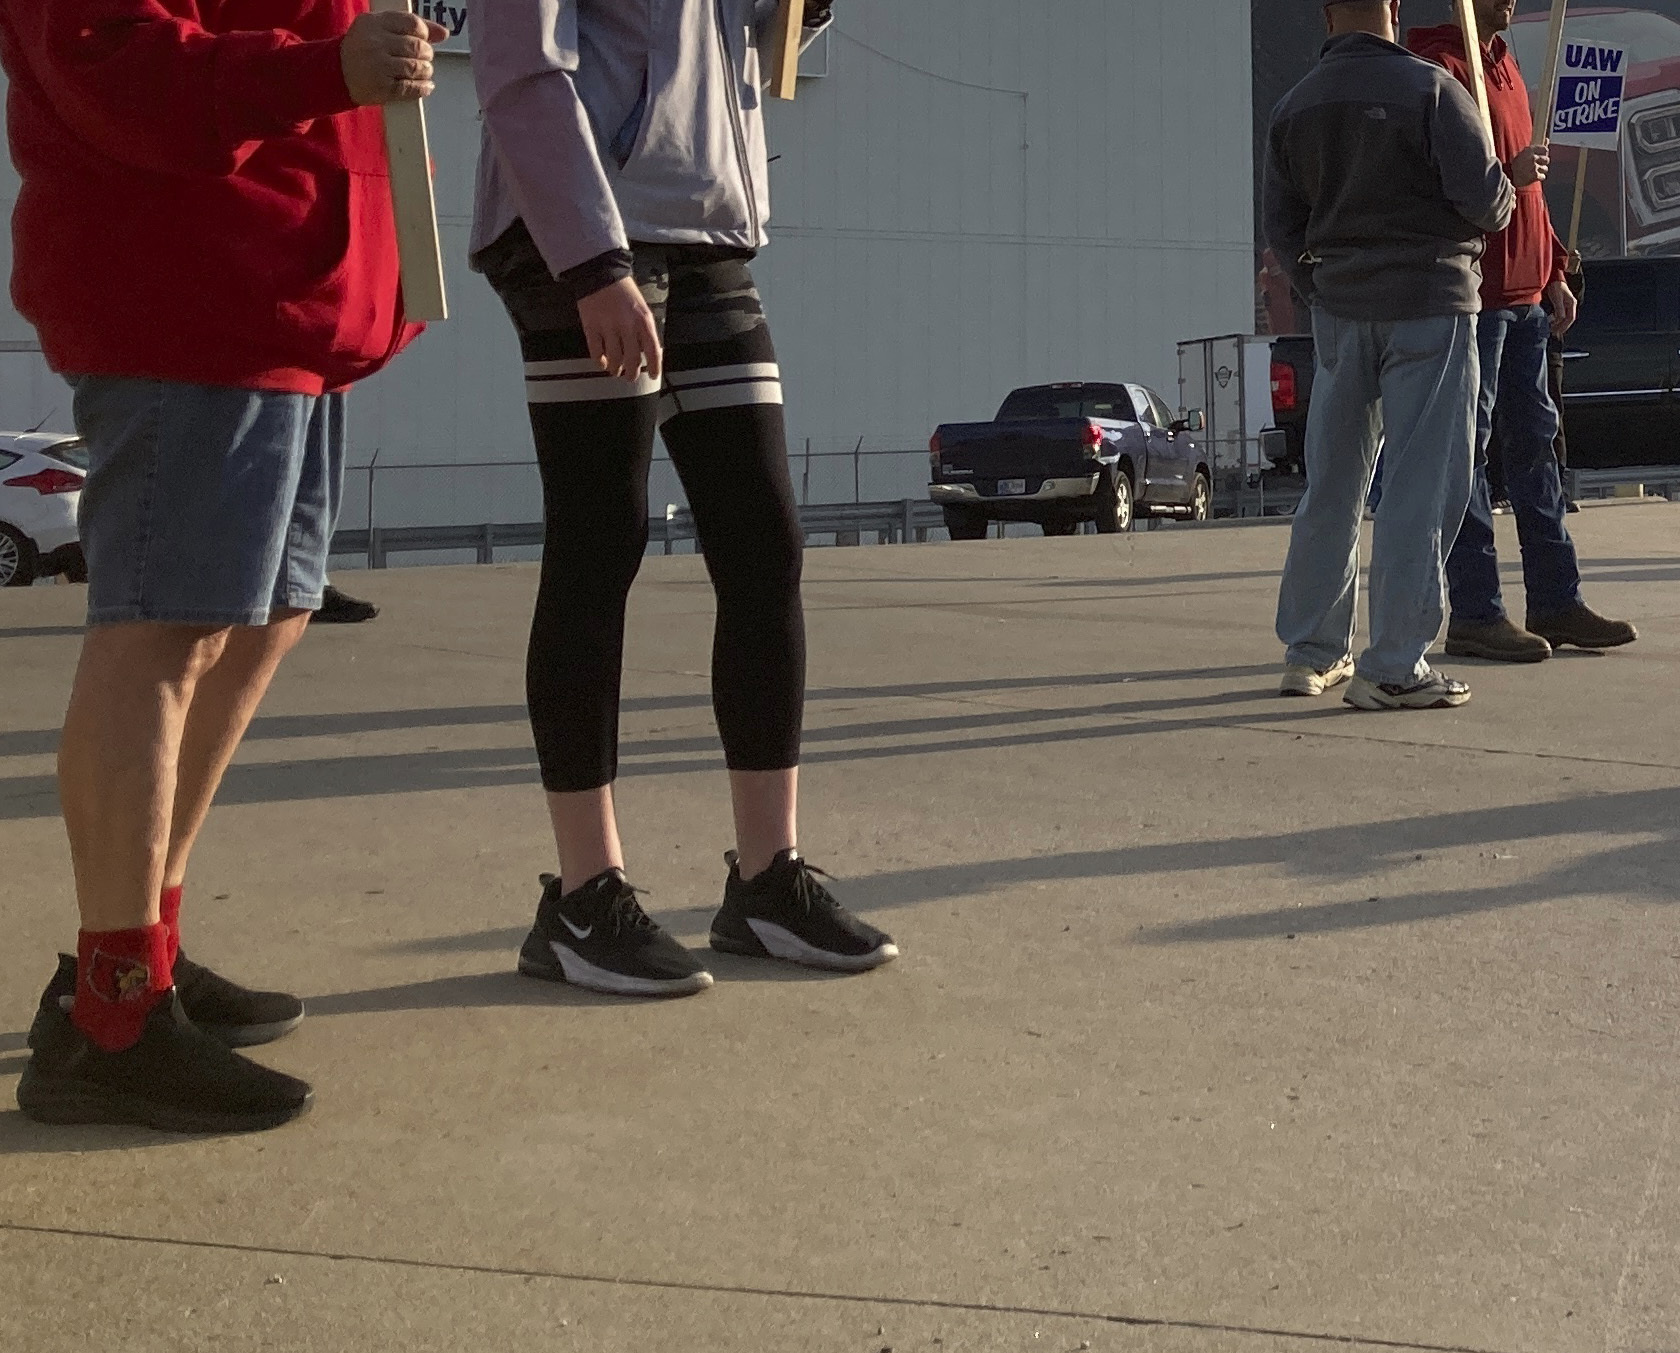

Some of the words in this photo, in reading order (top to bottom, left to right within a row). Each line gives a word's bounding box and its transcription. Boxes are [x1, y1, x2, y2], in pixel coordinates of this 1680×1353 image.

[1565, 44, 1623, 72] UAW
[1575, 79, 1601, 103] ON
[1554, 98, 1619, 131] STRIKE
